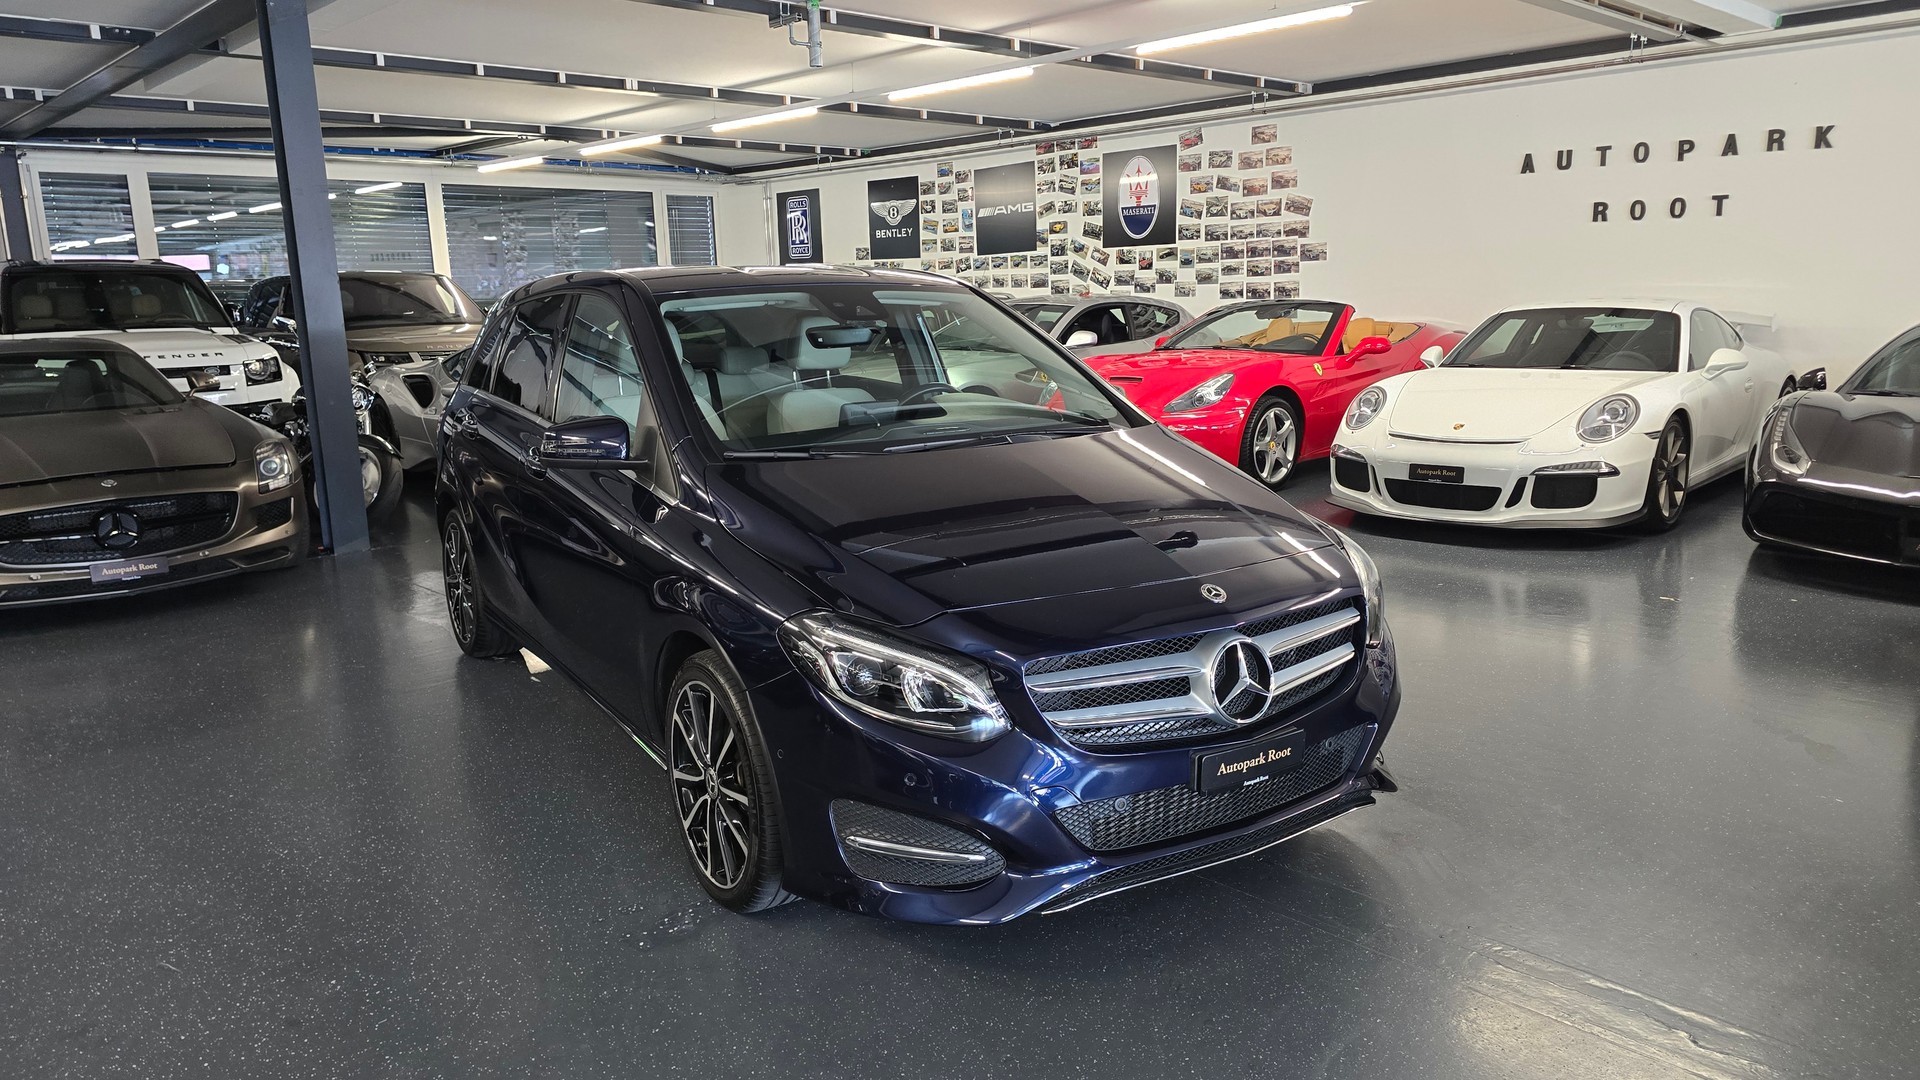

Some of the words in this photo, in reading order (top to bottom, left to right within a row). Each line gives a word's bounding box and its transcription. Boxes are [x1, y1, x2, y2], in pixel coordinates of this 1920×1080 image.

[1520, 125, 1835, 174] AUTOPARK
[790, 200, 807, 209] ROLLS
[995, 202, 1034, 216] AMG
[1592, 194, 1730, 222] ROOT
[1122, 206, 1155, 216] MASERATI
[875, 228, 913, 239] BENTLEY
[792, 246, 809, 254] ROYCE
[143, 352, 224, 360] FENDER
[1416, 468, 1442, 476] Autopark
[1442, 469, 1457, 477] Root
[101, 564, 138, 576] Autopark
[138, 563, 158, 571] Root
[1217, 752, 1266, 776] Autopark
[1267, 747, 1292, 762] Root
